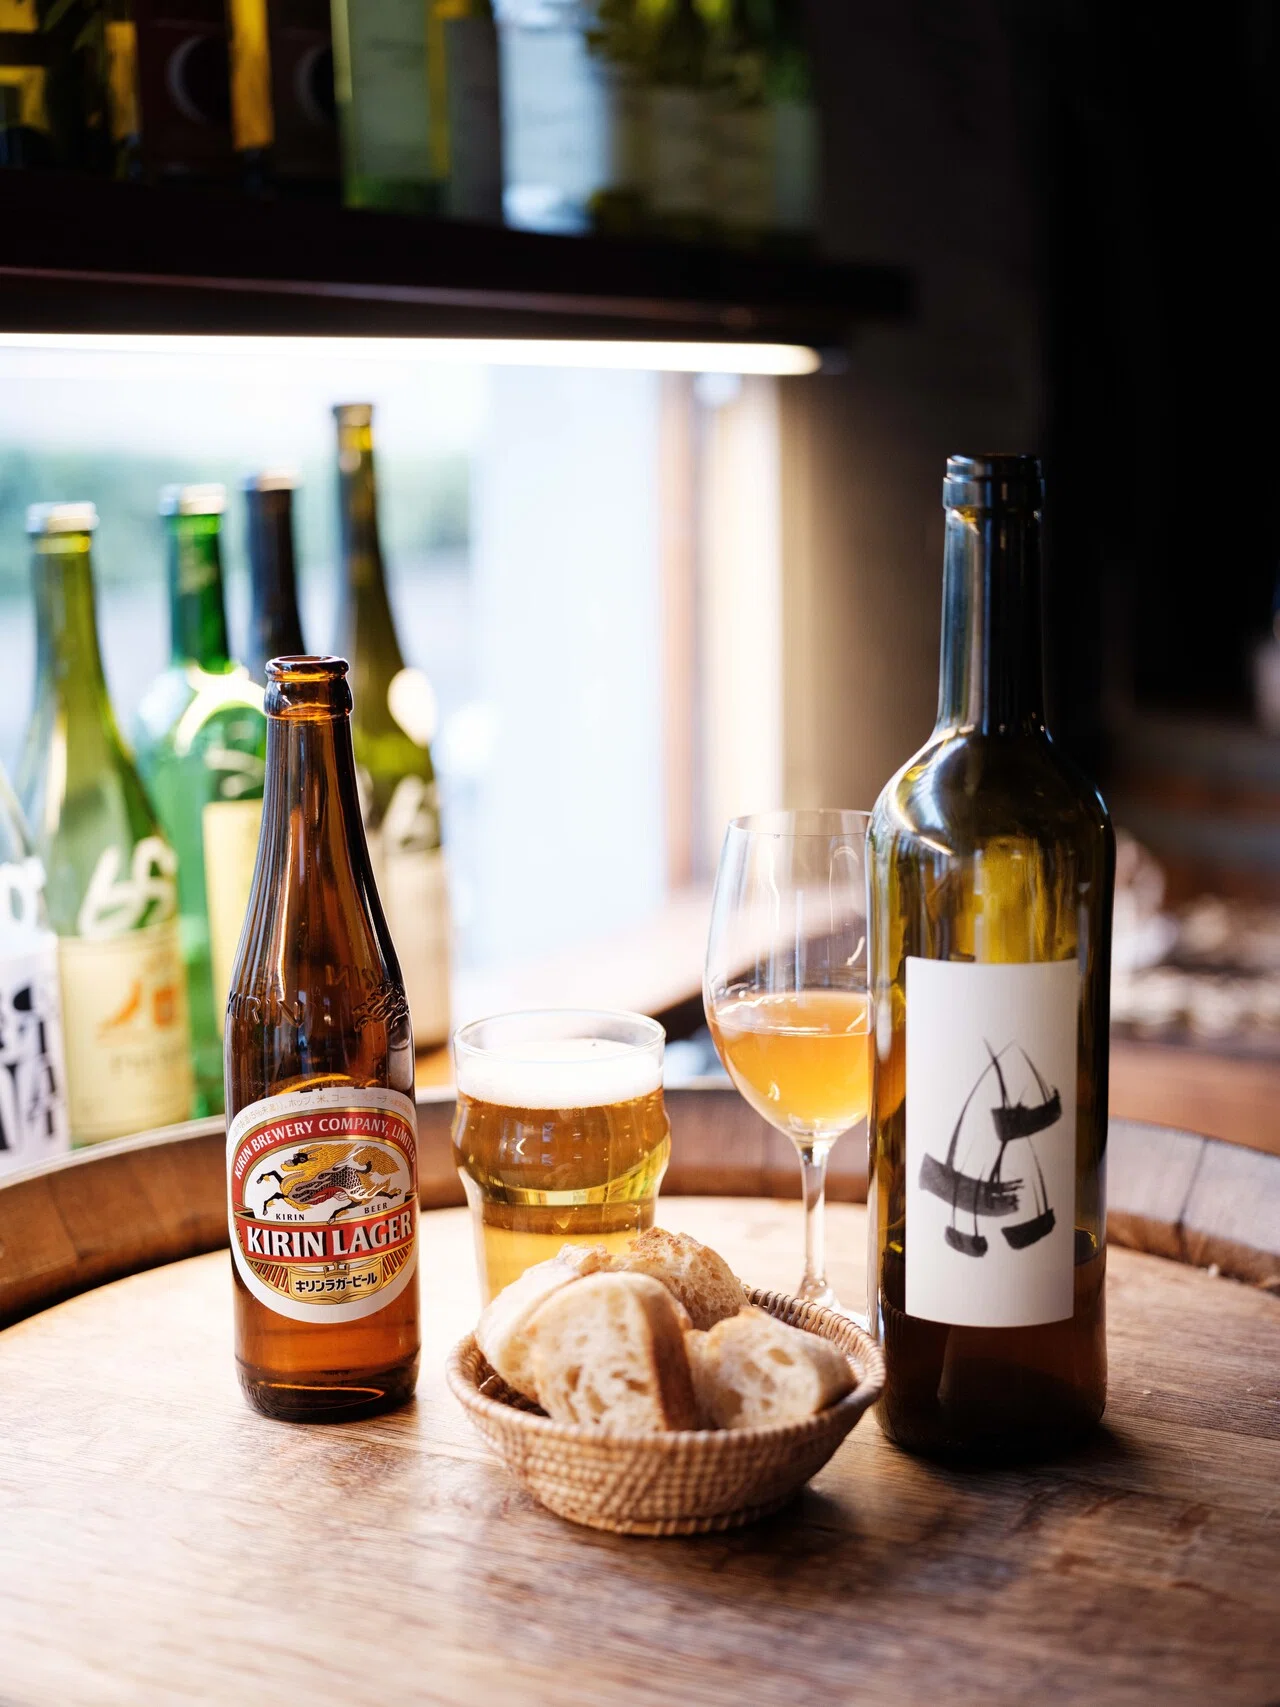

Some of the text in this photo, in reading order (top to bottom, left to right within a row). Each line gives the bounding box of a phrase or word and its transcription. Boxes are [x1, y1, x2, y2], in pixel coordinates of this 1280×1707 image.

[234, 1146, 254, 1180] KIRIN
[250, 1120, 314, 1152] BREWERY
[318, 1118, 389, 1137] COMPANY,
[275, 1203, 388, 1221] KIRIN BEER
[246, 1210, 413, 1257] KIRIN LAGER
[295, 1272, 378, 1293] キリンラガービール
